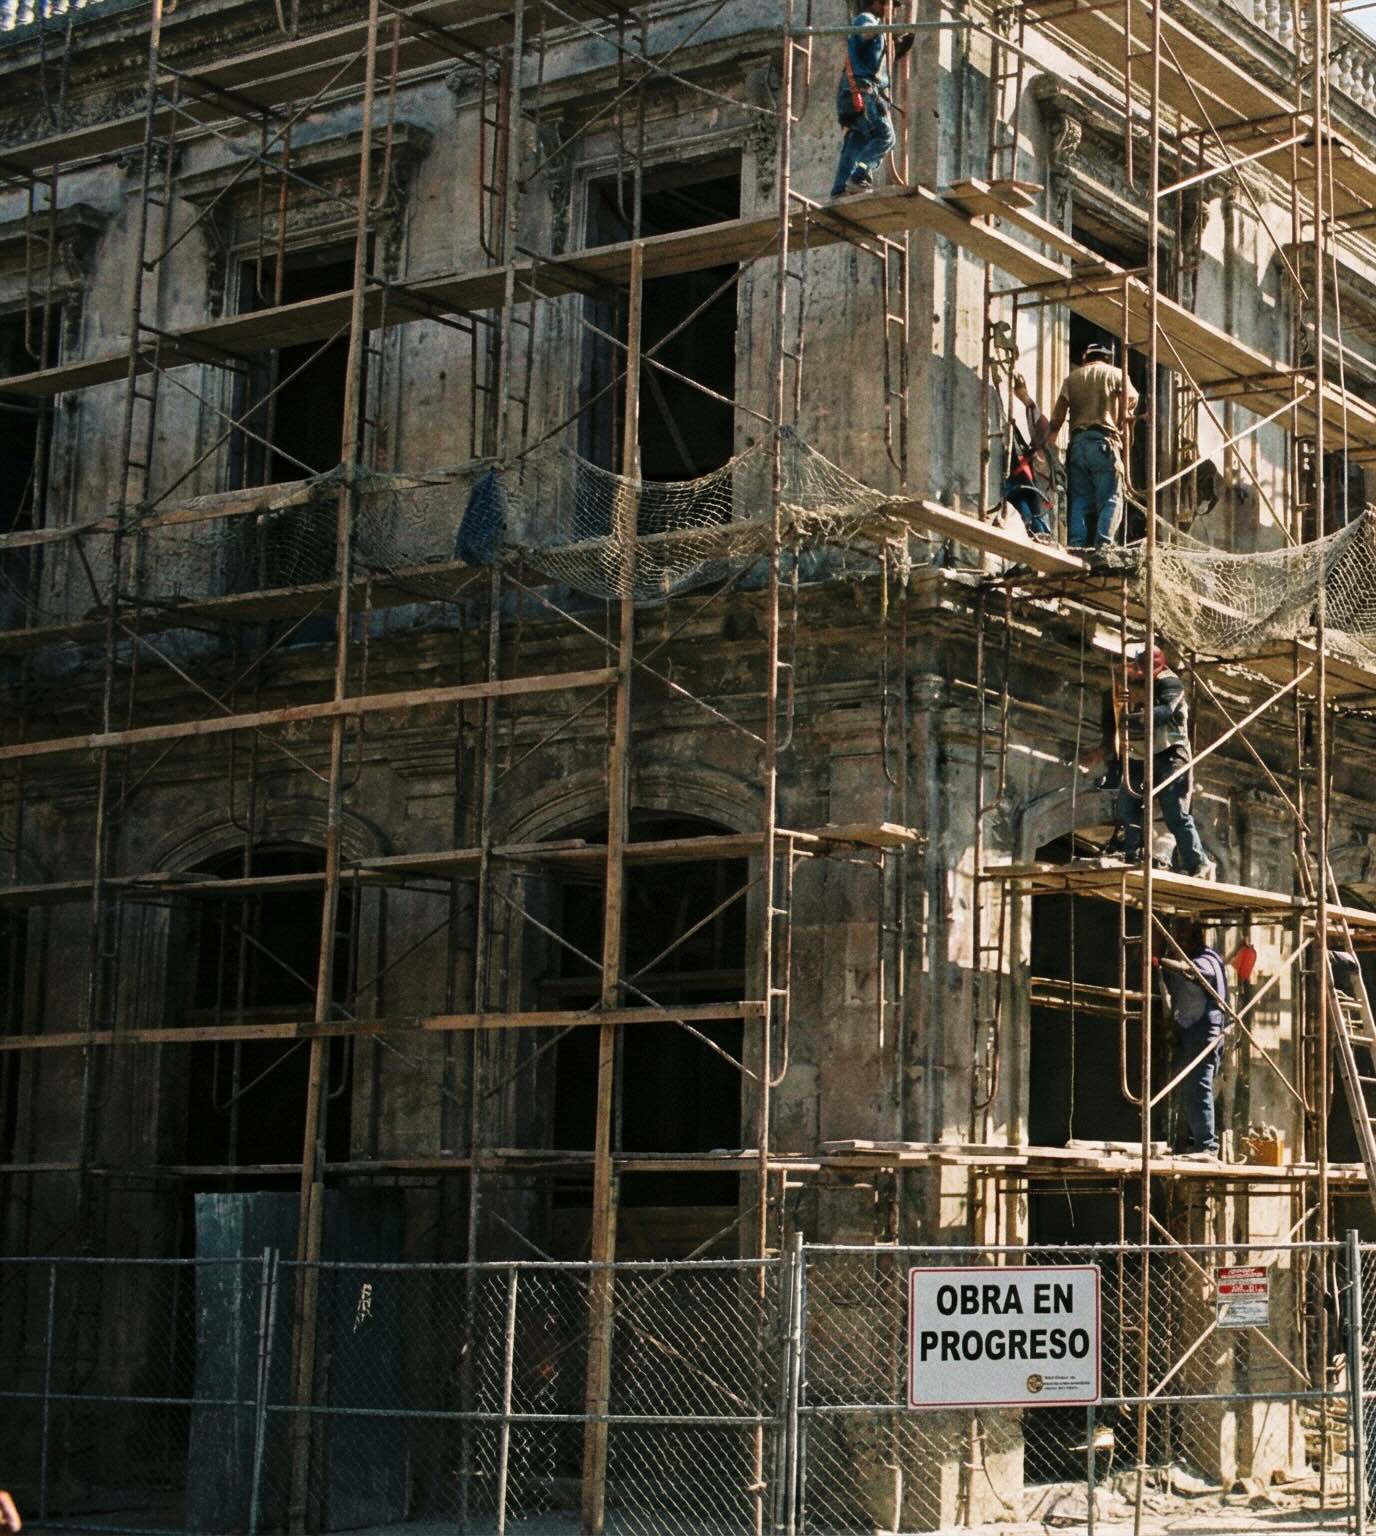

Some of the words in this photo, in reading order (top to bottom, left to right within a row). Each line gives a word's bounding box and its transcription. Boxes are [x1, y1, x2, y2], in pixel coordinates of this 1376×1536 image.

[936, 1284, 1023, 1315] OBRA
[1034, 1283, 1073, 1314] EN
[920, 1328, 1090, 1361] PROGRESO
